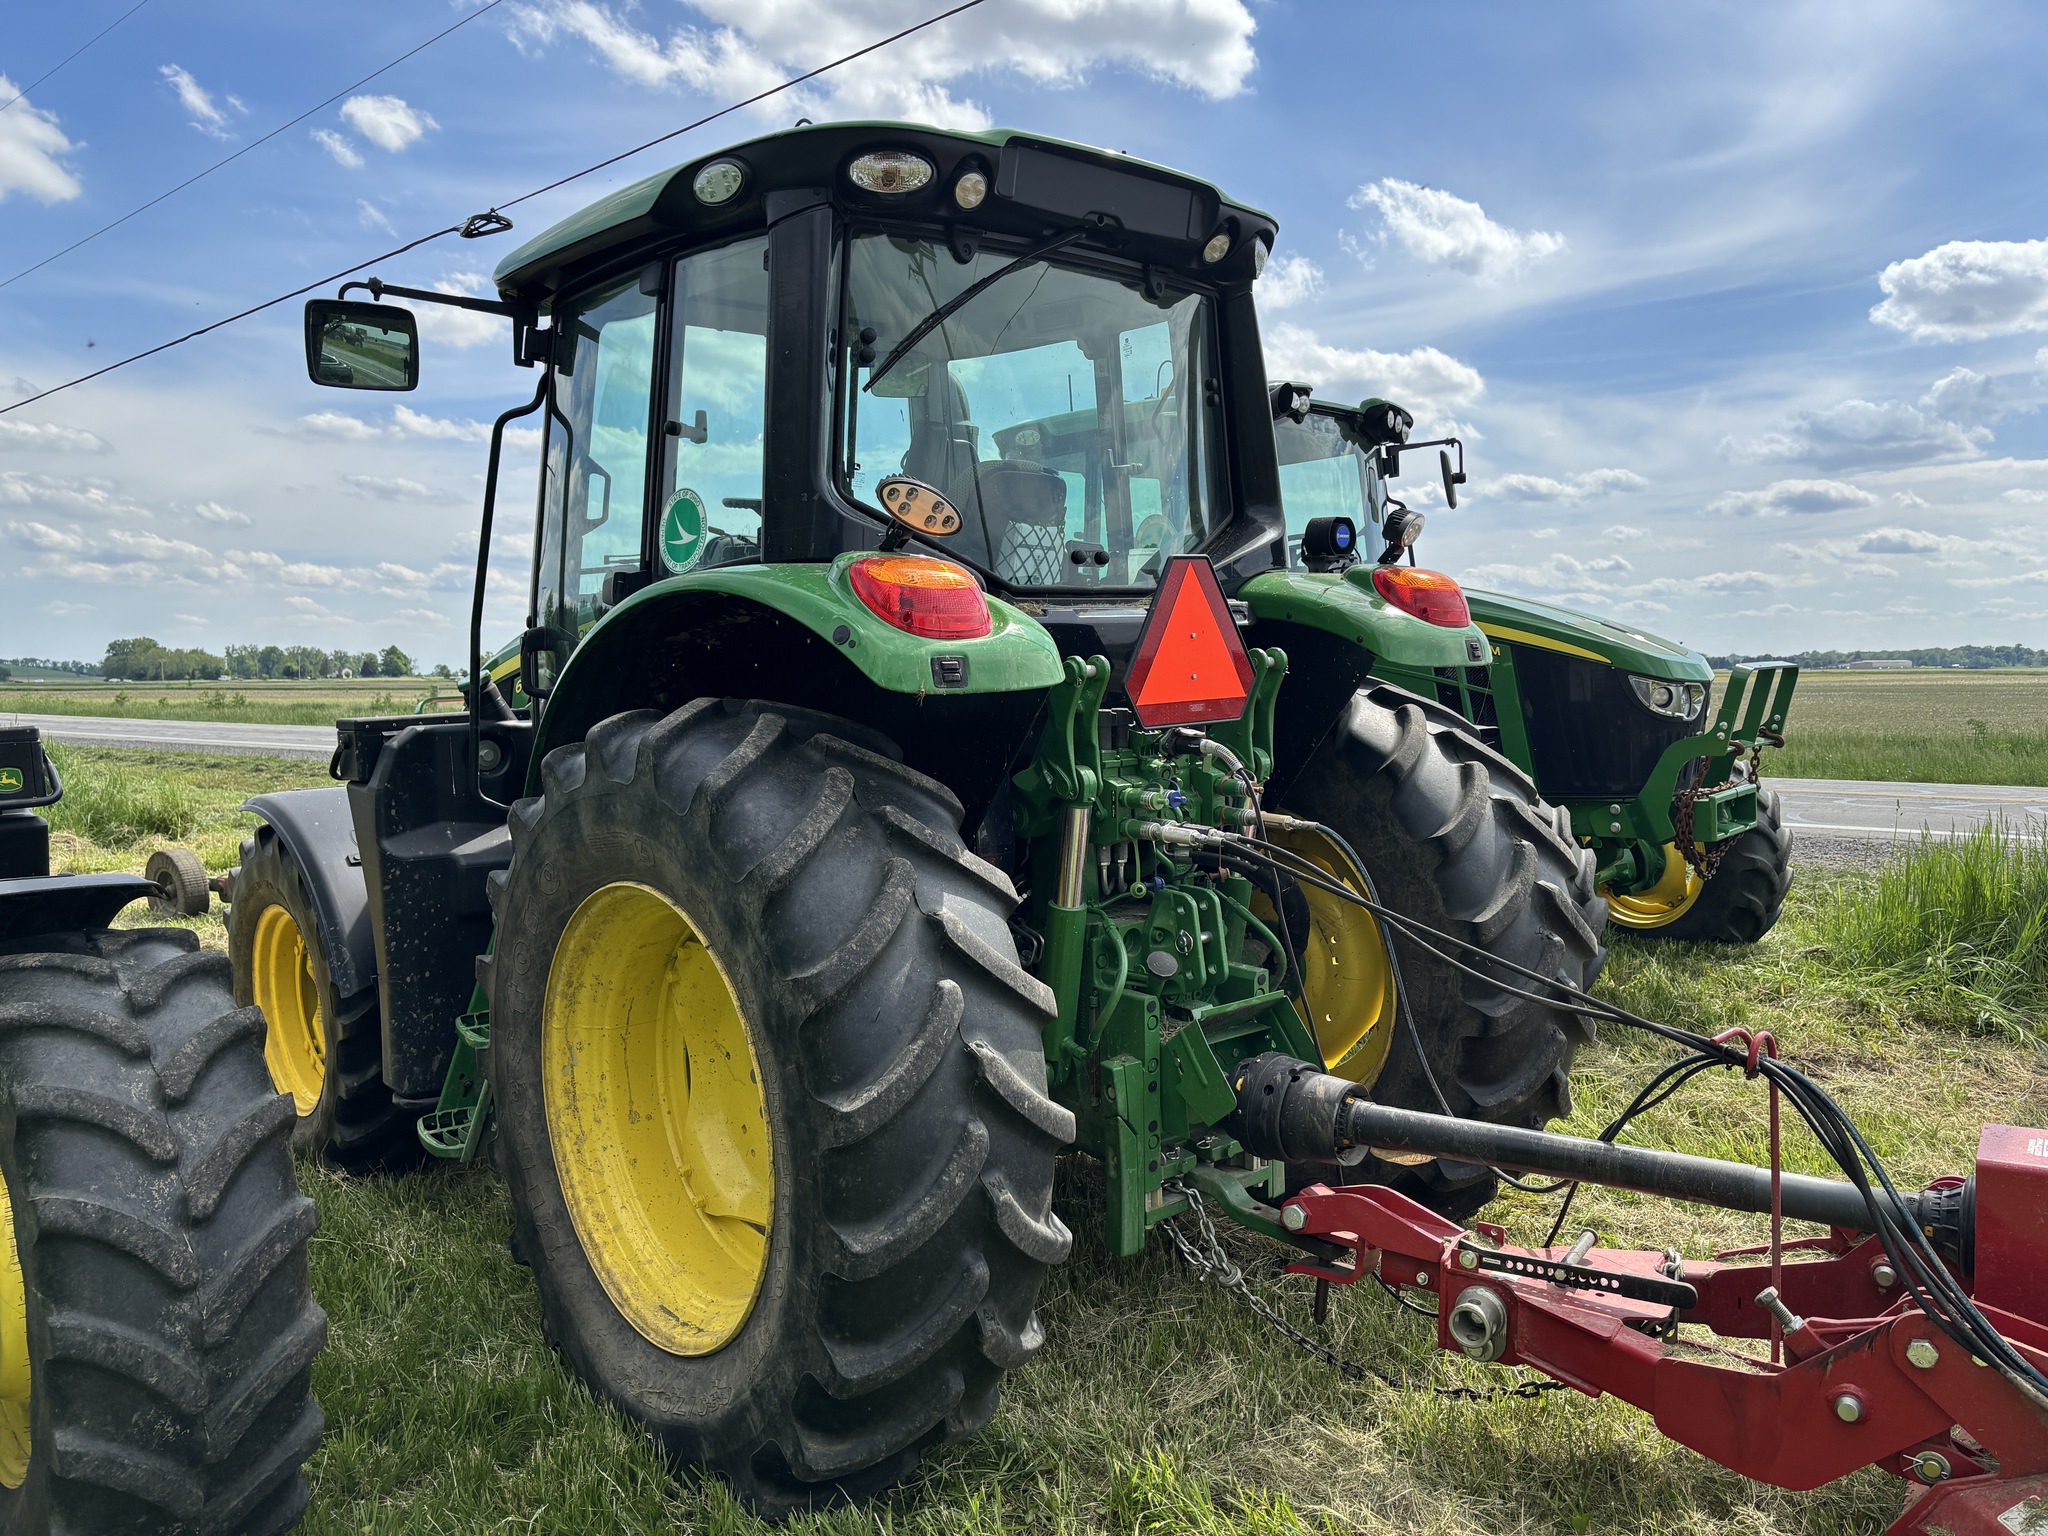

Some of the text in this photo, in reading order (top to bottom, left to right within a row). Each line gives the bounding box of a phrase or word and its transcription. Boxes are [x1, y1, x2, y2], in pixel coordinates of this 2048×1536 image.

[668, 492, 682, 507] STATE
[689, 492, 701, 507] OHIO
[678, 516, 706, 570] TRANSPORTATION
